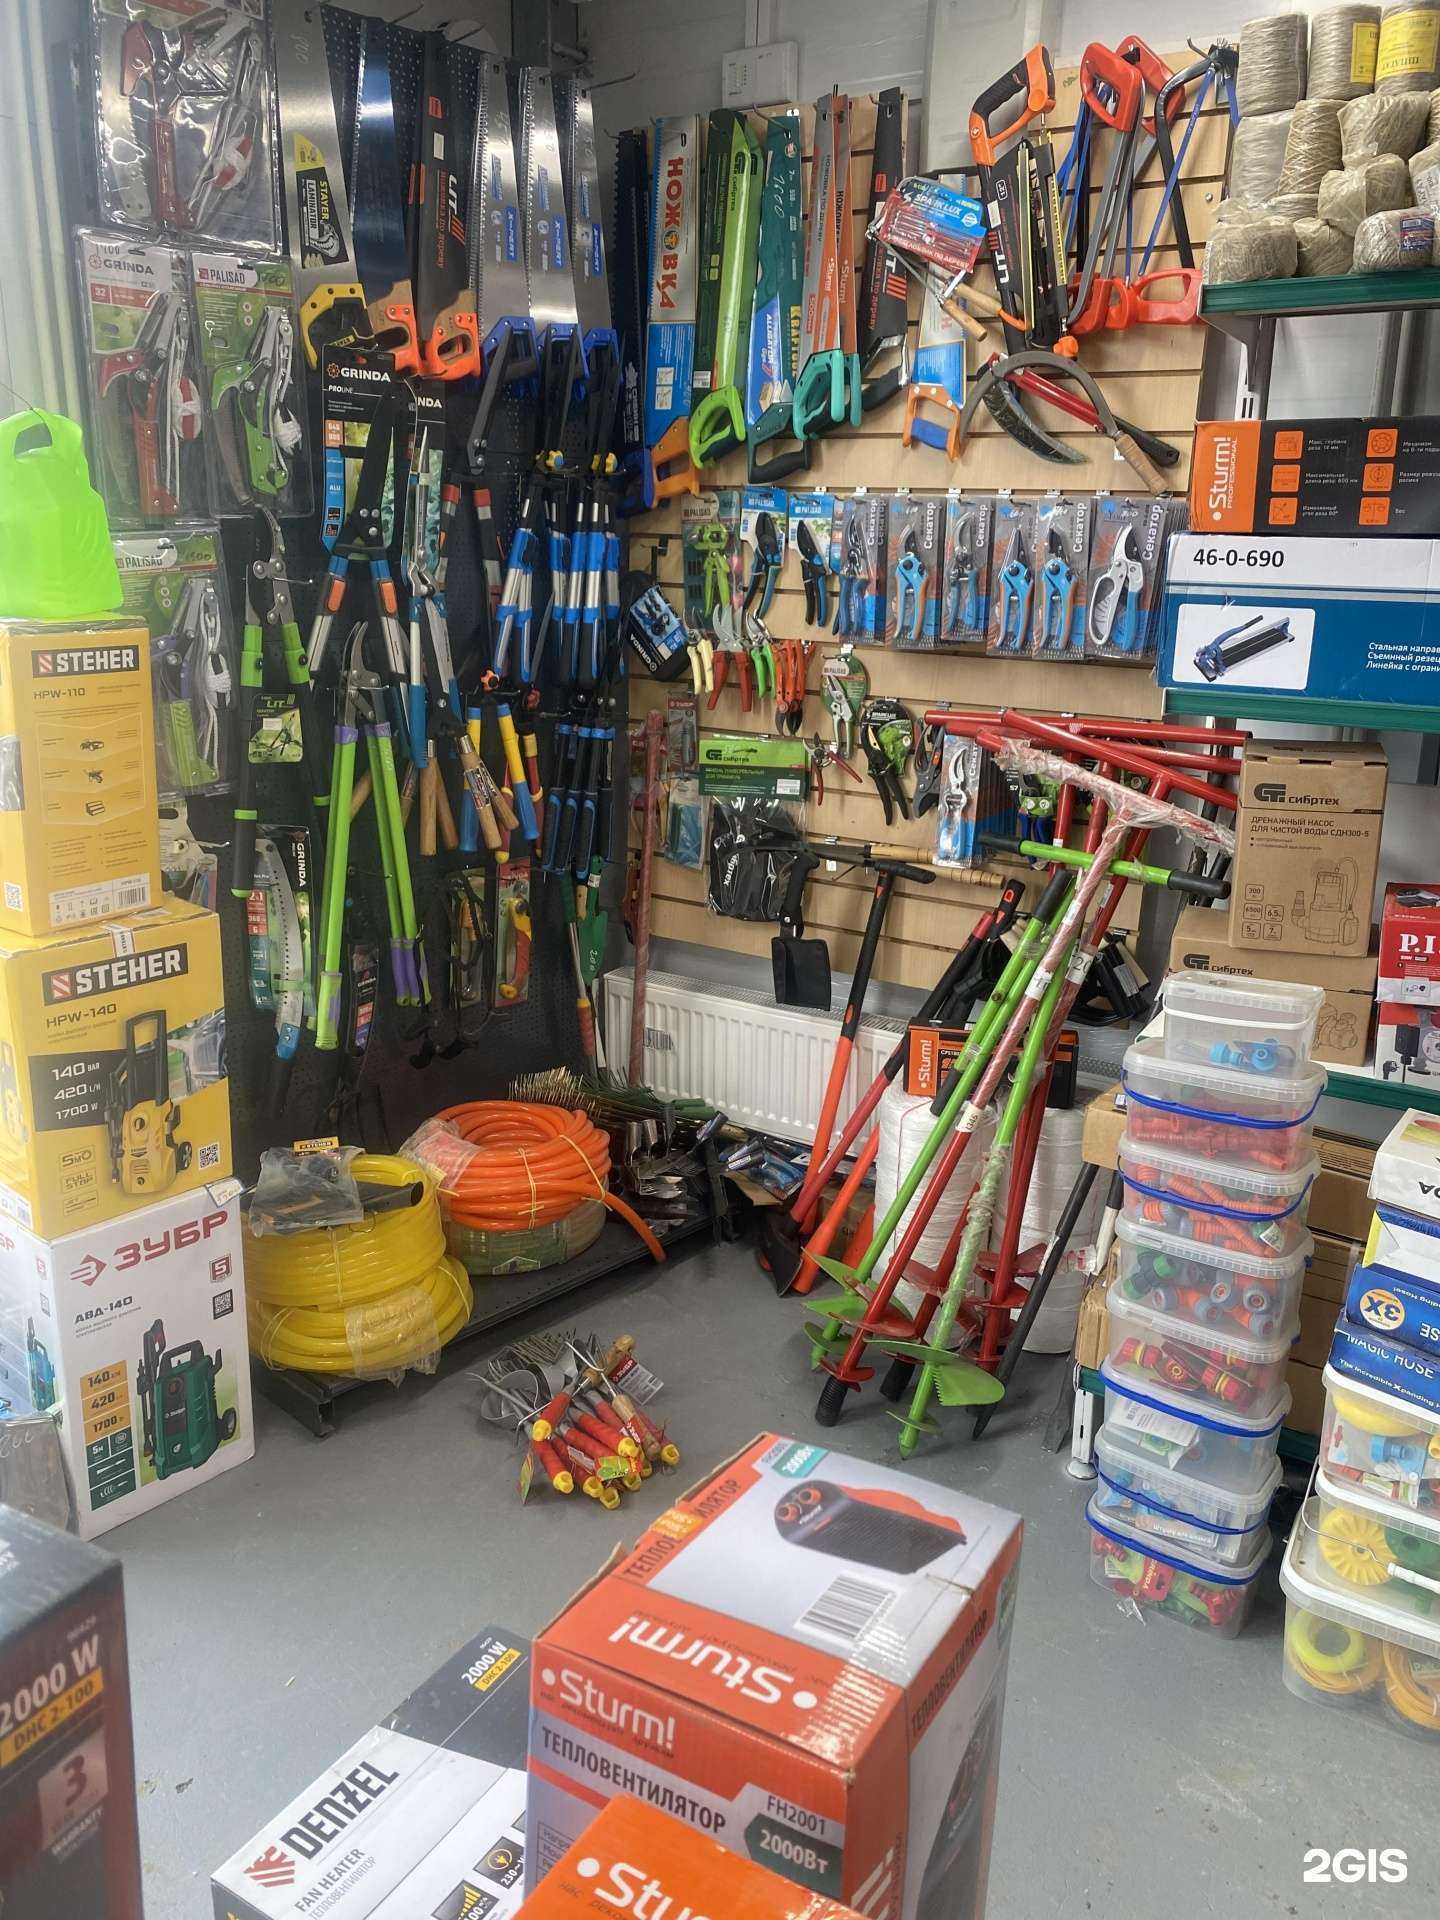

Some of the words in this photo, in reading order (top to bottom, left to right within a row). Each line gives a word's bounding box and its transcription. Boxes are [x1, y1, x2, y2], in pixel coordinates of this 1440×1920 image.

[308, 180, 318, 229] LAMINATOR
[319, 180, 330, 221] STAYER
[448, 174, 457, 216] LIT
[103, 258, 154, 276] GRINDA
[210, 269, 246, 284] PALISAD
[328, 384, 354, 394] PROLINE
[340, 367, 391, 382] GRINDA
[417, 396, 443, 409] NDA
[1208, 437, 1231, 509] Sturm!
[1228, 437, 1237, 509] PROFESSIONAL
[867, 500, 878, 546] Секатор
[923, 502, 937, 549] Секатор
[976, 504, 989, 548] Секатор
[1073, 502, 1088, 553] Секатор
[1142, 504, 1166, 561] Секатор
[1193, 548, 1286, 568] 46-0-690
[56, 649, 134, 673] STEHER
[1366, 660, 1403, 670] Линейка
[1369, 642, 1408, 652] Стальная
[33, 687, 86, 701] HPW-110
[1288, 795, 1340, 806] сибртех
[1251, 817, 1306, 827] ДРЕНАЖНЫЙ
[1308, 819, 1334, 827] НАСОС
[1251, 825, 1268, 834] ДЛЯ
[1270, 826, 1302, 835] ЧИСТОЙ
[1304, 828, 1329, 837] ВОДЫ
[297, 842, 307, 887] GRINDA
[75, 948, 182, 995] STEHER
[1211, 964, 1253, 976] сибртех
[46, 1003, 117, 1028] HPW-140
[52, 1062, 86, 1081] 140
[918, 1039, 932, 1083] Sturm!
[54, 1083, 87, 1100] 420
[56, 1103, 89, 1120] 1700
[113, 1210, 228, 1273] ЗУБР
[75, 1296, 133, 1324] АВД-140
[1364, 1295, 1401, 1321] 3X
[1347, 1334, 1390, 1359] MAGIC
[88, 1371, 110, 1388] 140
[1354, 1367, 1393, 1388] Incredible
[1392, 1384, 1434, 1408] Xpanding
[91, 1392, 115, 1409] 420
[94, 1416, 118, 1433] 1700
[71, 1633, 100, 1677] W
[461, 1654, 495, 1685] 2000
[488, 1640, 508, 1656] W
[607, 1615, 795, 1705] Sturm!
[482, 1671, 498, 1685] DHC
[14, 1716, 48, 1751] DHC
[50, 1678, 94, 1722] 2-100
[560, 1668, 676, 1749] Sturm!
[65, 1755, 87, 1806] 3
[542, 1725, 727, 1834] ТЕПЛОВЕНТИЛЯТОР
[279, 1761, 400, 1861] DENZEL
[767, 1794, 826, 1836] FH2001
[760, 1828, 829, 1874] 2000Вт
[294, 1887, 323, 1912] FAN
[318, 1848, 366, 1891] HEATER
